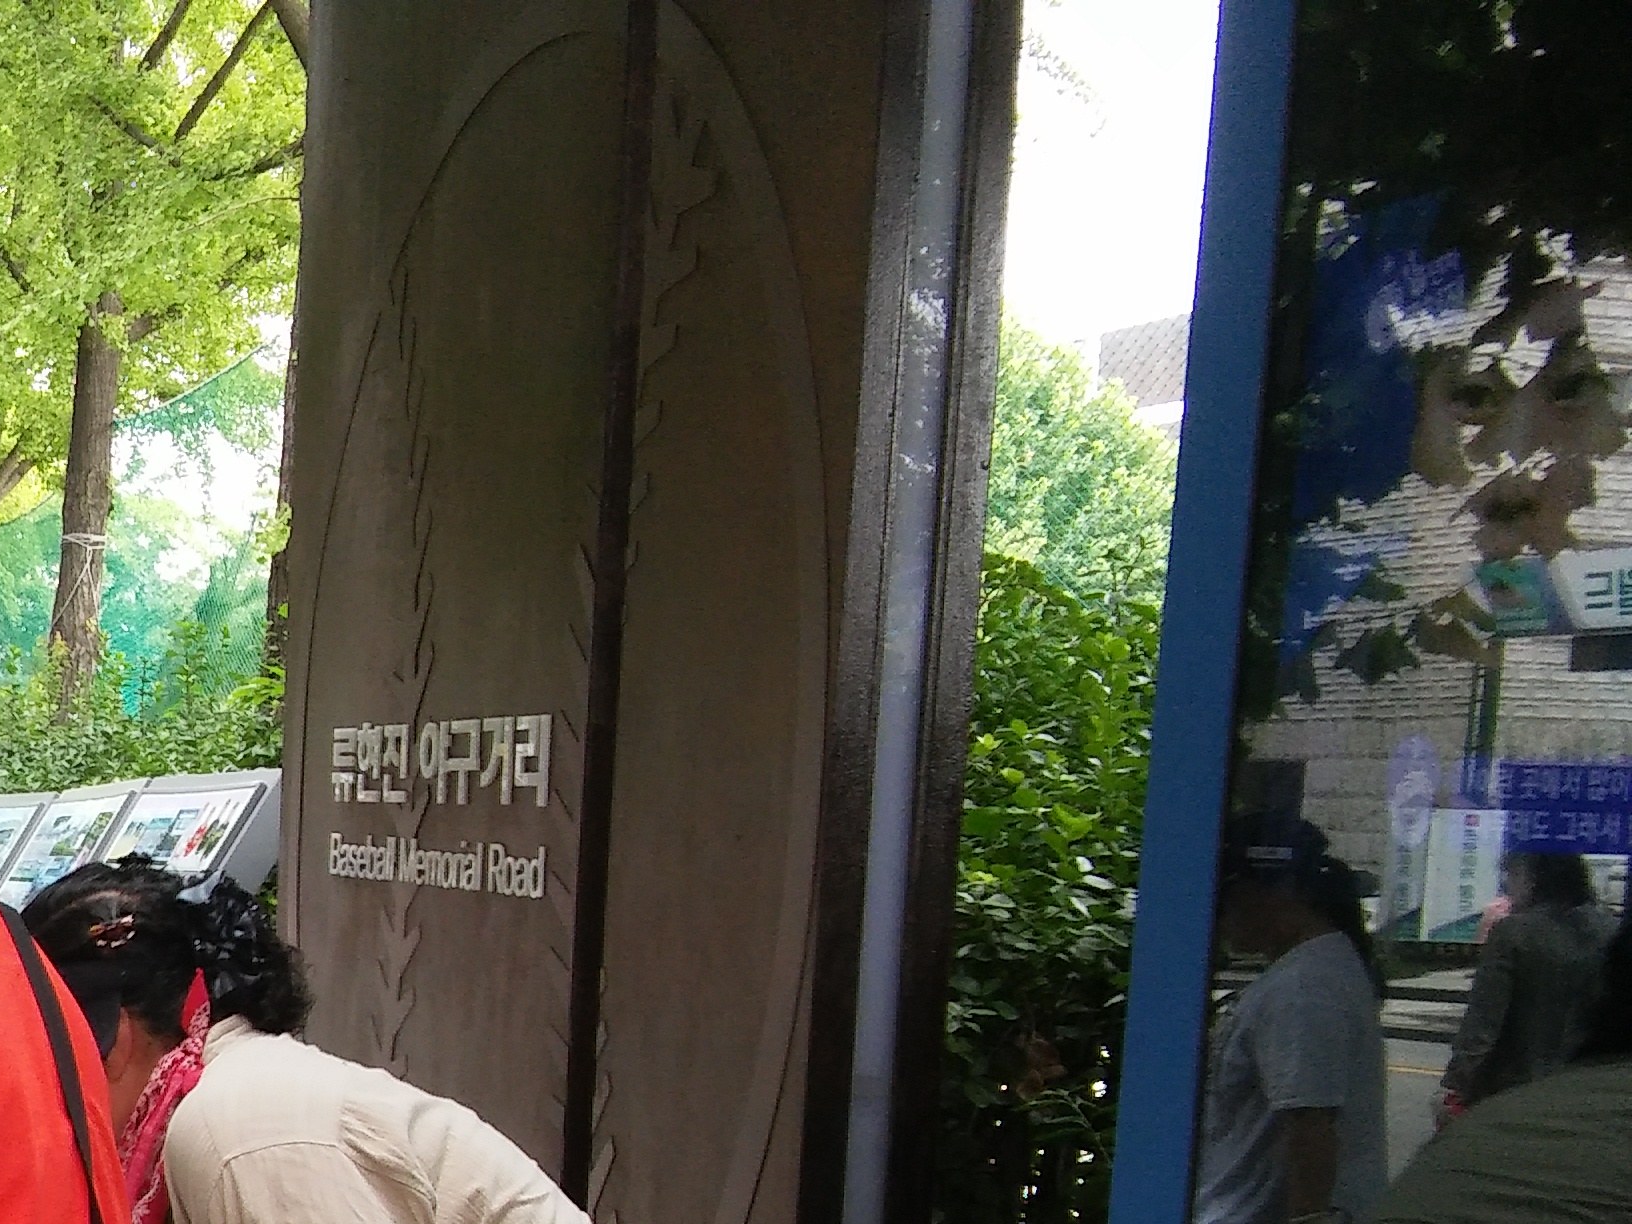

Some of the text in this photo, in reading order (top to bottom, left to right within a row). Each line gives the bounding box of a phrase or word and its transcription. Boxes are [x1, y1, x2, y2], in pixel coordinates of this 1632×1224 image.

[331, 714, 552, 807] 류현진 야구거리
[328, 832, 546, 898] Baseball Memorial Road
